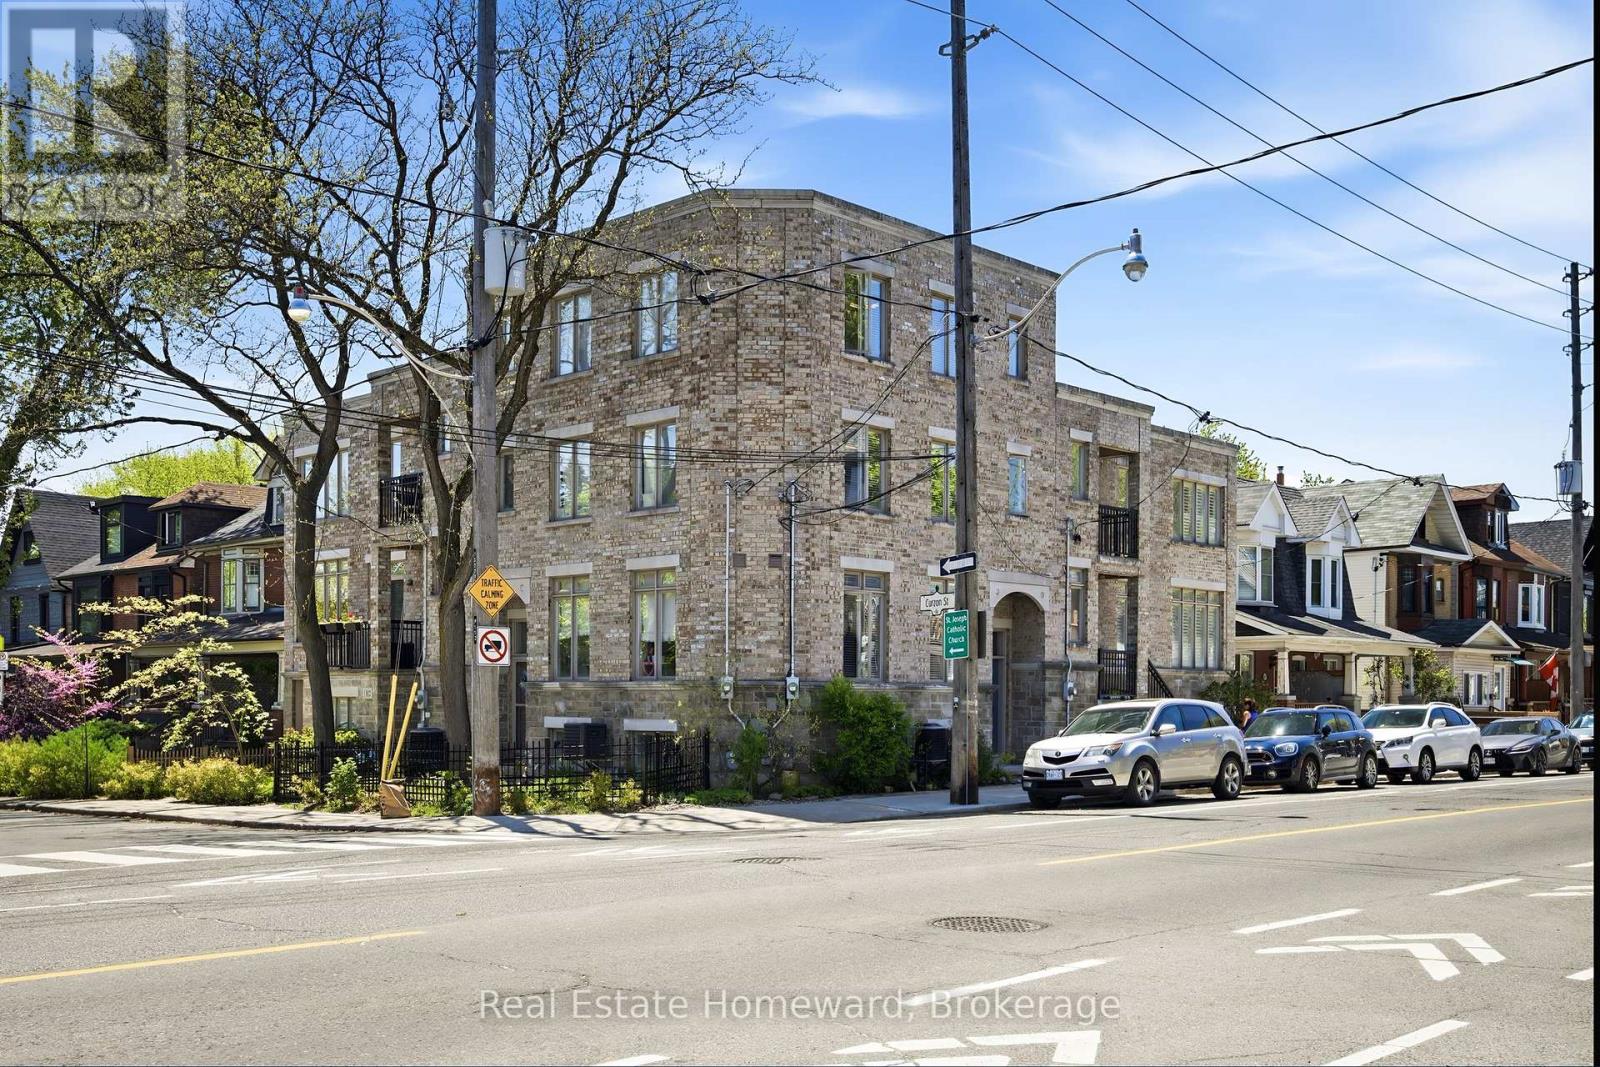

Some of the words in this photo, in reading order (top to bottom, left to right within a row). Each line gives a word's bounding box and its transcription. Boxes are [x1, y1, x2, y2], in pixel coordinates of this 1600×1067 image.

[481, 578, 502, 587] TRAFFIC
[481, 590, 504, 598] CALMING
[485, 600, 499, 609] ZONE
[925, 599, 942, 608] Curzon
[943, 596, 949, 606] St
[952, 615, 967, 624] Joseph
[946, 625, 966, 634] Catholic
